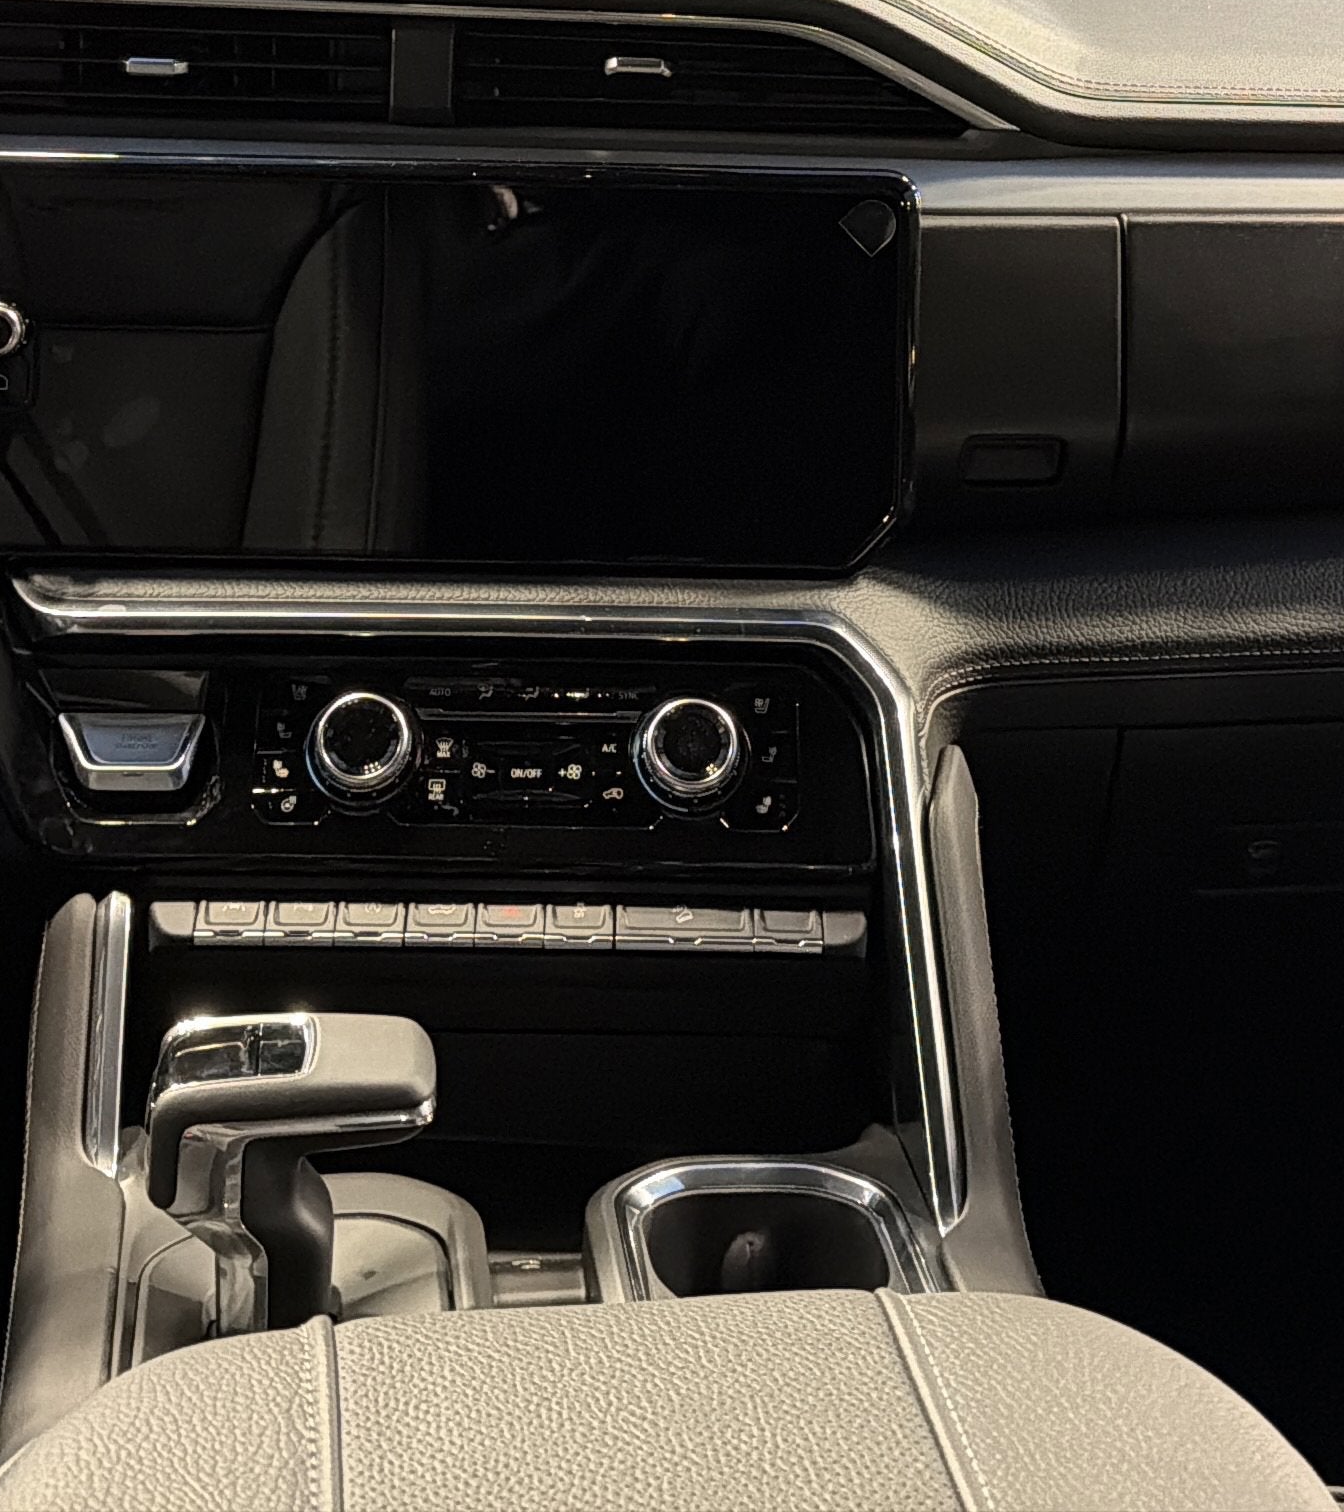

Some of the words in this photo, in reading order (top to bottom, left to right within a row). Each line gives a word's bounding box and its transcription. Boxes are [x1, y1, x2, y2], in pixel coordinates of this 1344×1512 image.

[429, 687, 451, 697] AUTO
[601, 744, 617, 753] A/C
[511, 768, 543, 778] ON/OFF
